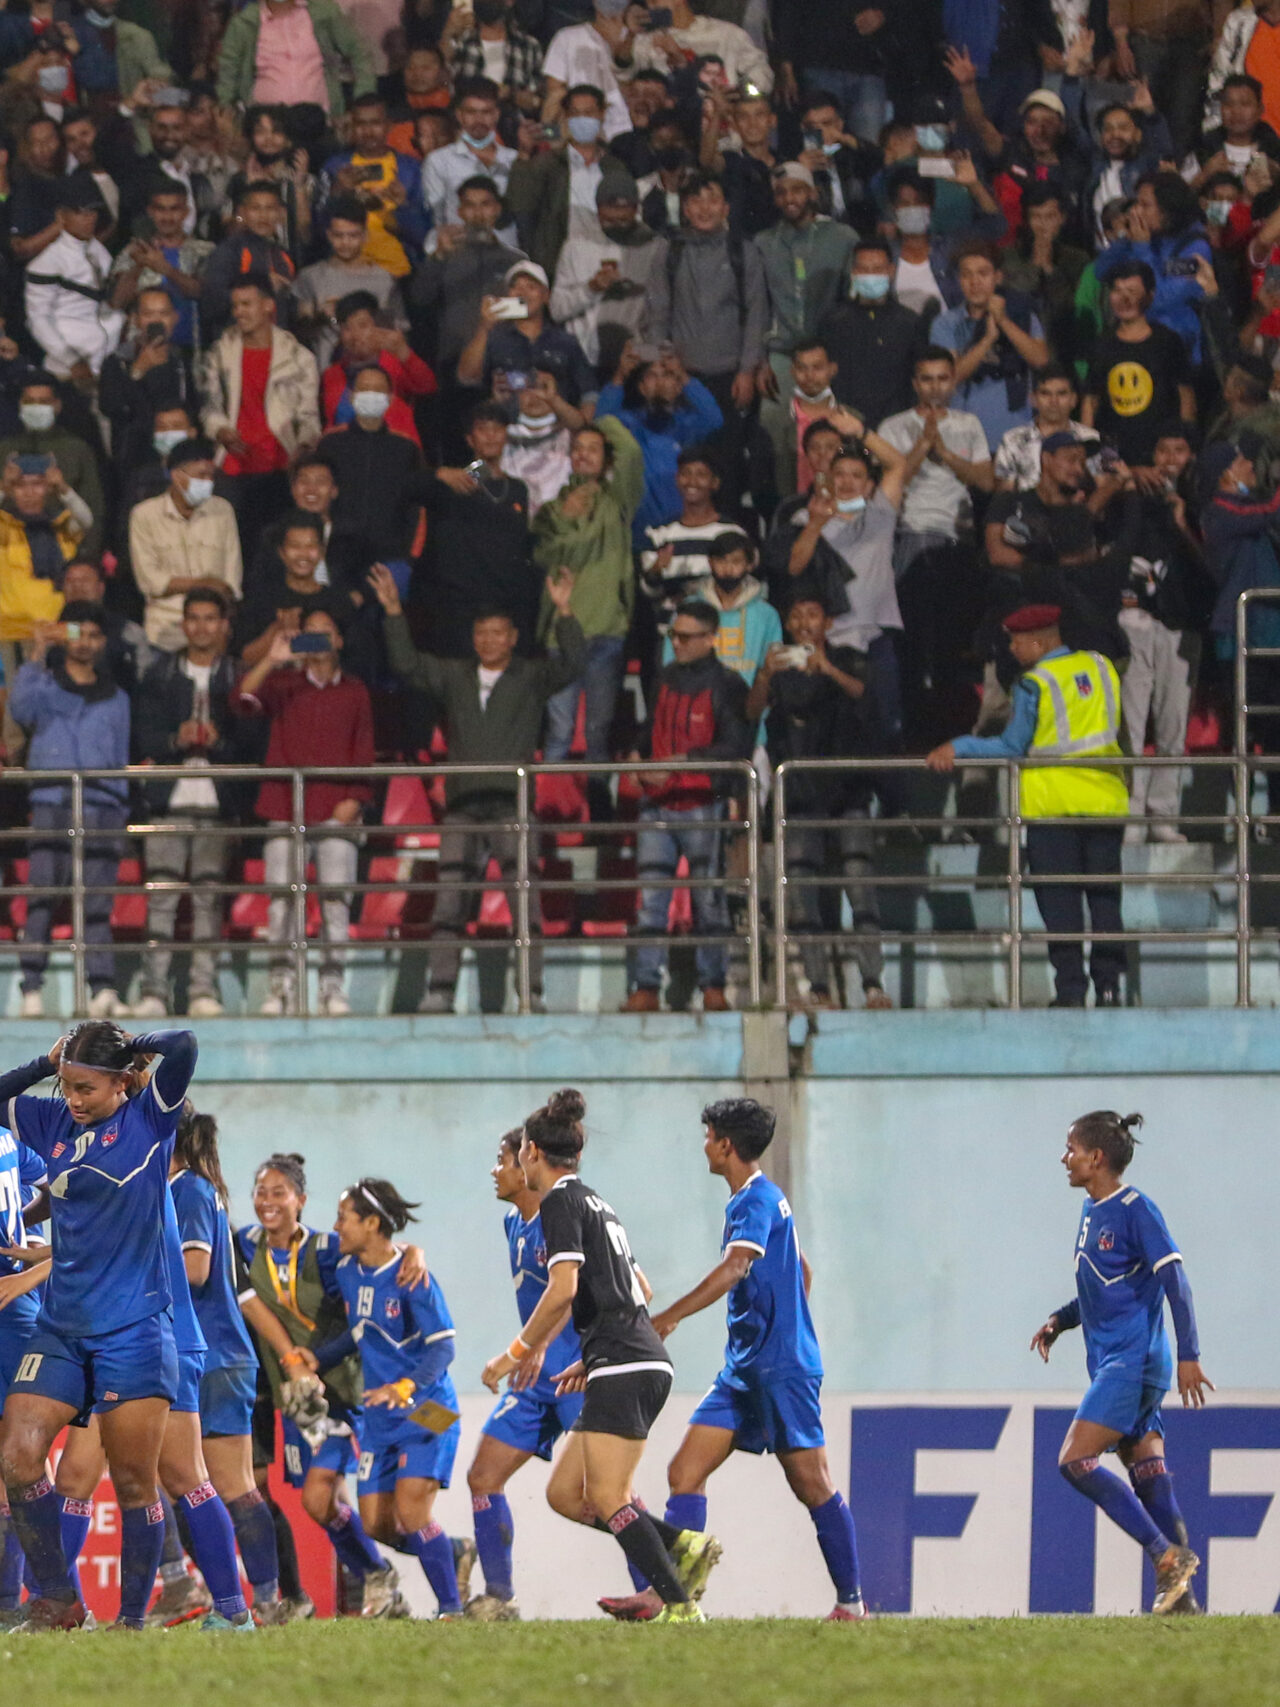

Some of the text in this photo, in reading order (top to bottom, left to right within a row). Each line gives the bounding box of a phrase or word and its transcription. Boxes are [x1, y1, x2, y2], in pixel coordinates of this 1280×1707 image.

[1076, 1216, 1092, 1249] 5
[356, 1285, 375, 1318] 19
[14, 1353, 44, 1383] 10
[284, 1444, 303, 1476] 18
